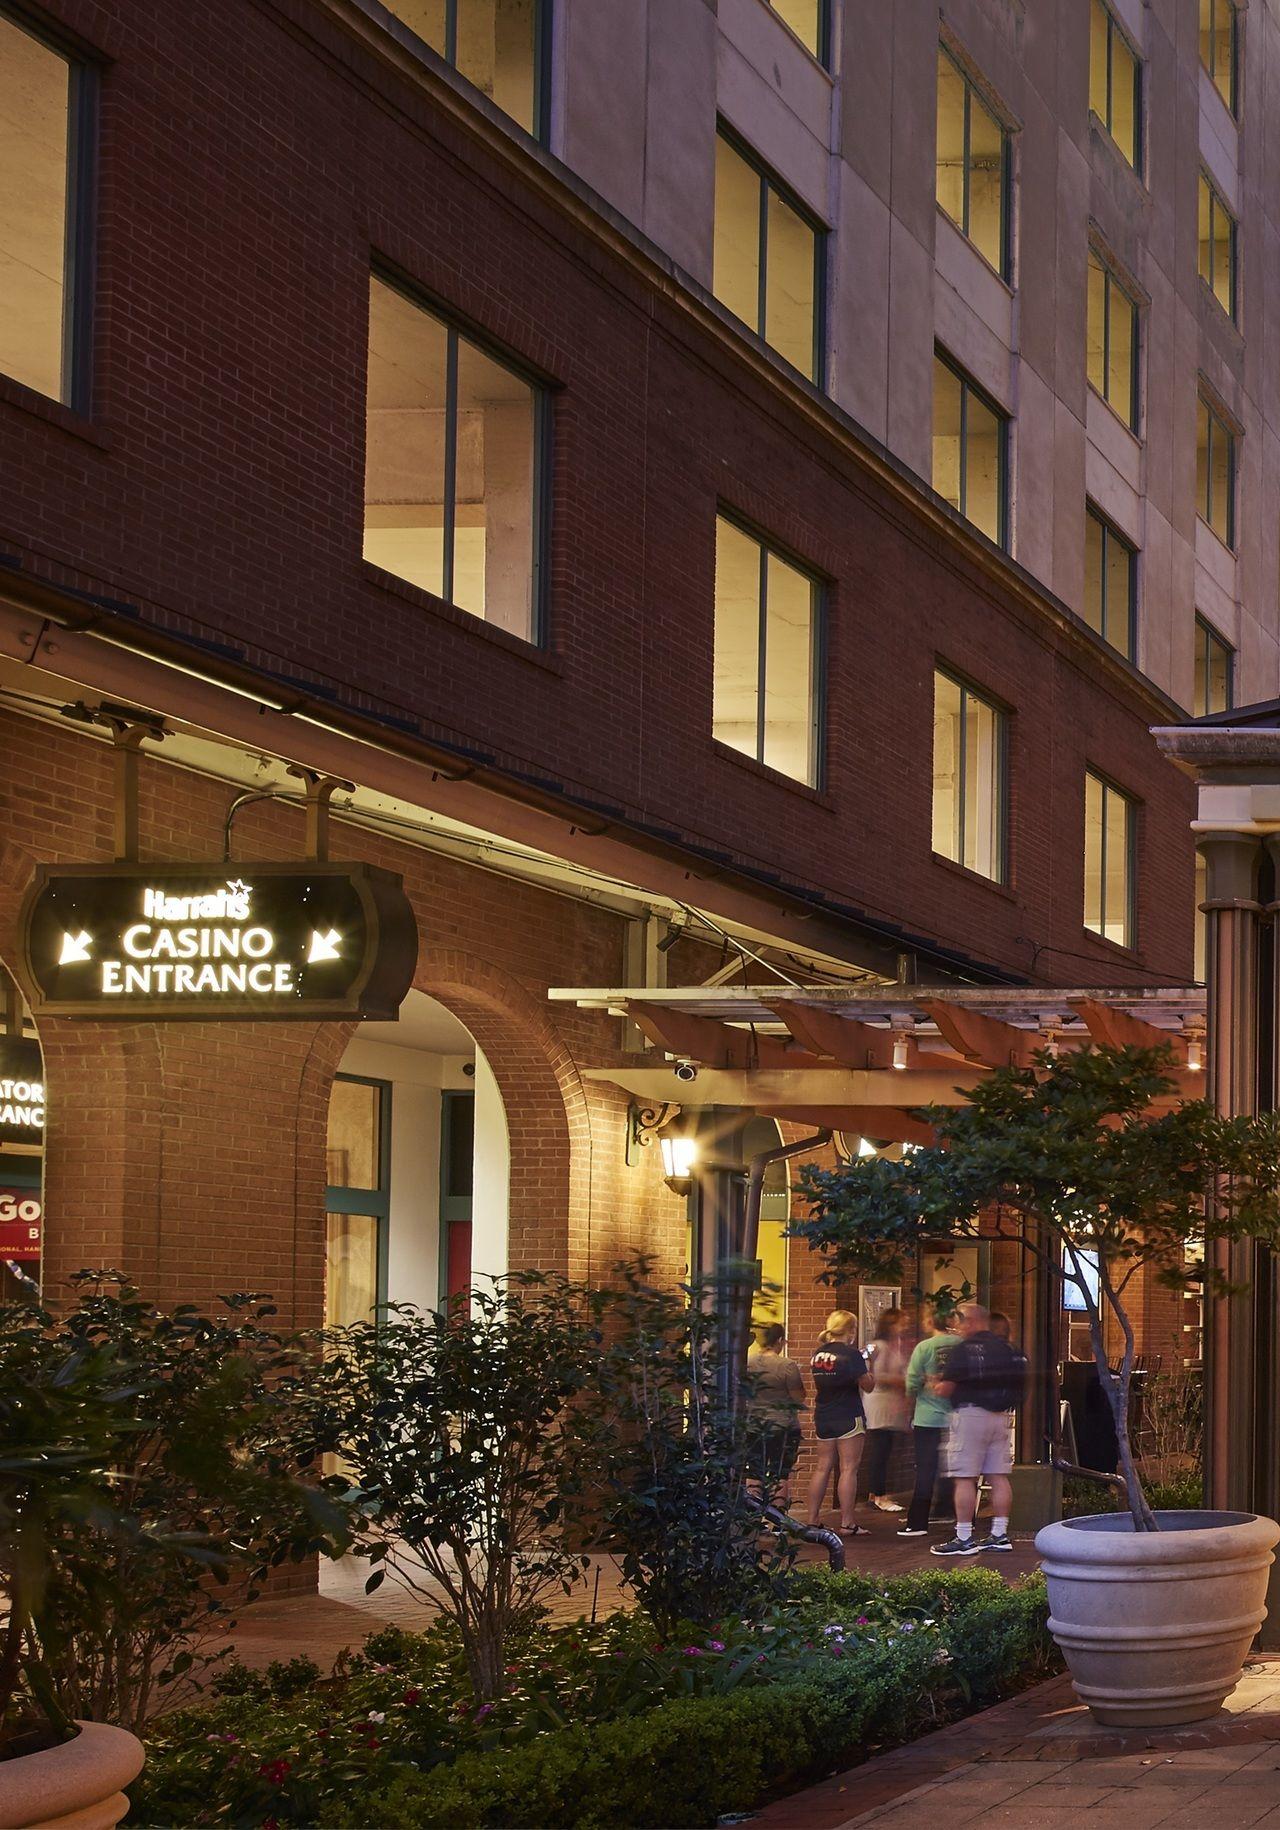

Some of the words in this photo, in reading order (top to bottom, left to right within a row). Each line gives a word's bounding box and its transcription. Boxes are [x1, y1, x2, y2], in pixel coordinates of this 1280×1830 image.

[124, 925, 273, 958] CASINO
[102, 962, 293, 993] ENTRANCE
[0, 1104, 45, 1127] ANC
